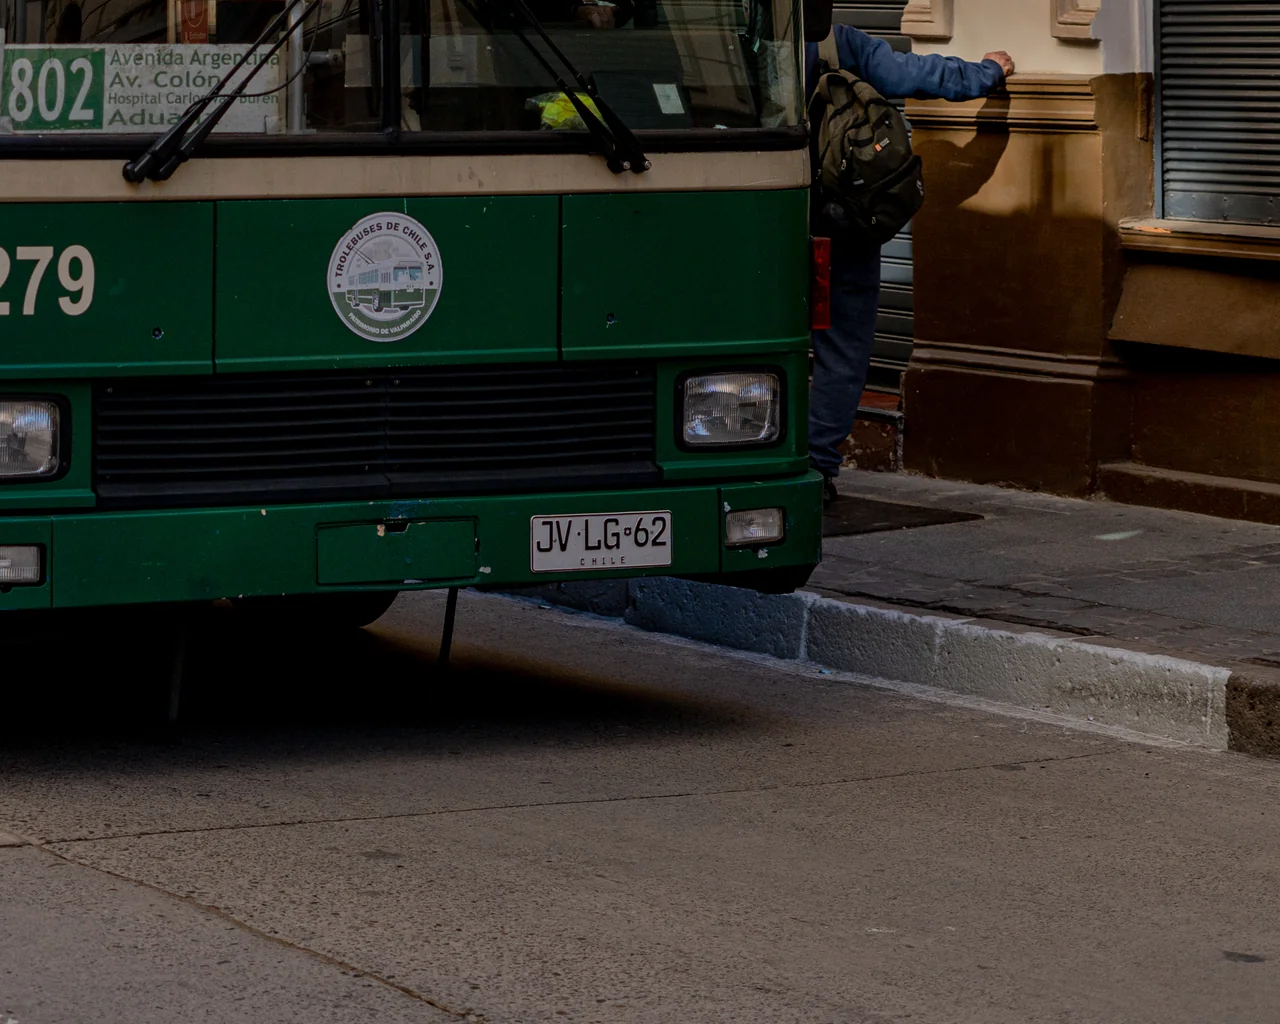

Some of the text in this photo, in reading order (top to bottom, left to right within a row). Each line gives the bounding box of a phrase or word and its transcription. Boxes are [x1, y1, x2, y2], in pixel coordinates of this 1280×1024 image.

[109, 49, 184, 66] Avenida
[109, 71, 220, 88] Av. Colón
[7, 57, 95, 121] 802
[108, 92, 162, 107] Hospital
[335, 221, 435, 278] TROLEBUSES DE CHILE S.A.
[348, 312, 380, 335] PATRIMONIO
[580, 556, 626, 566] CHILE
